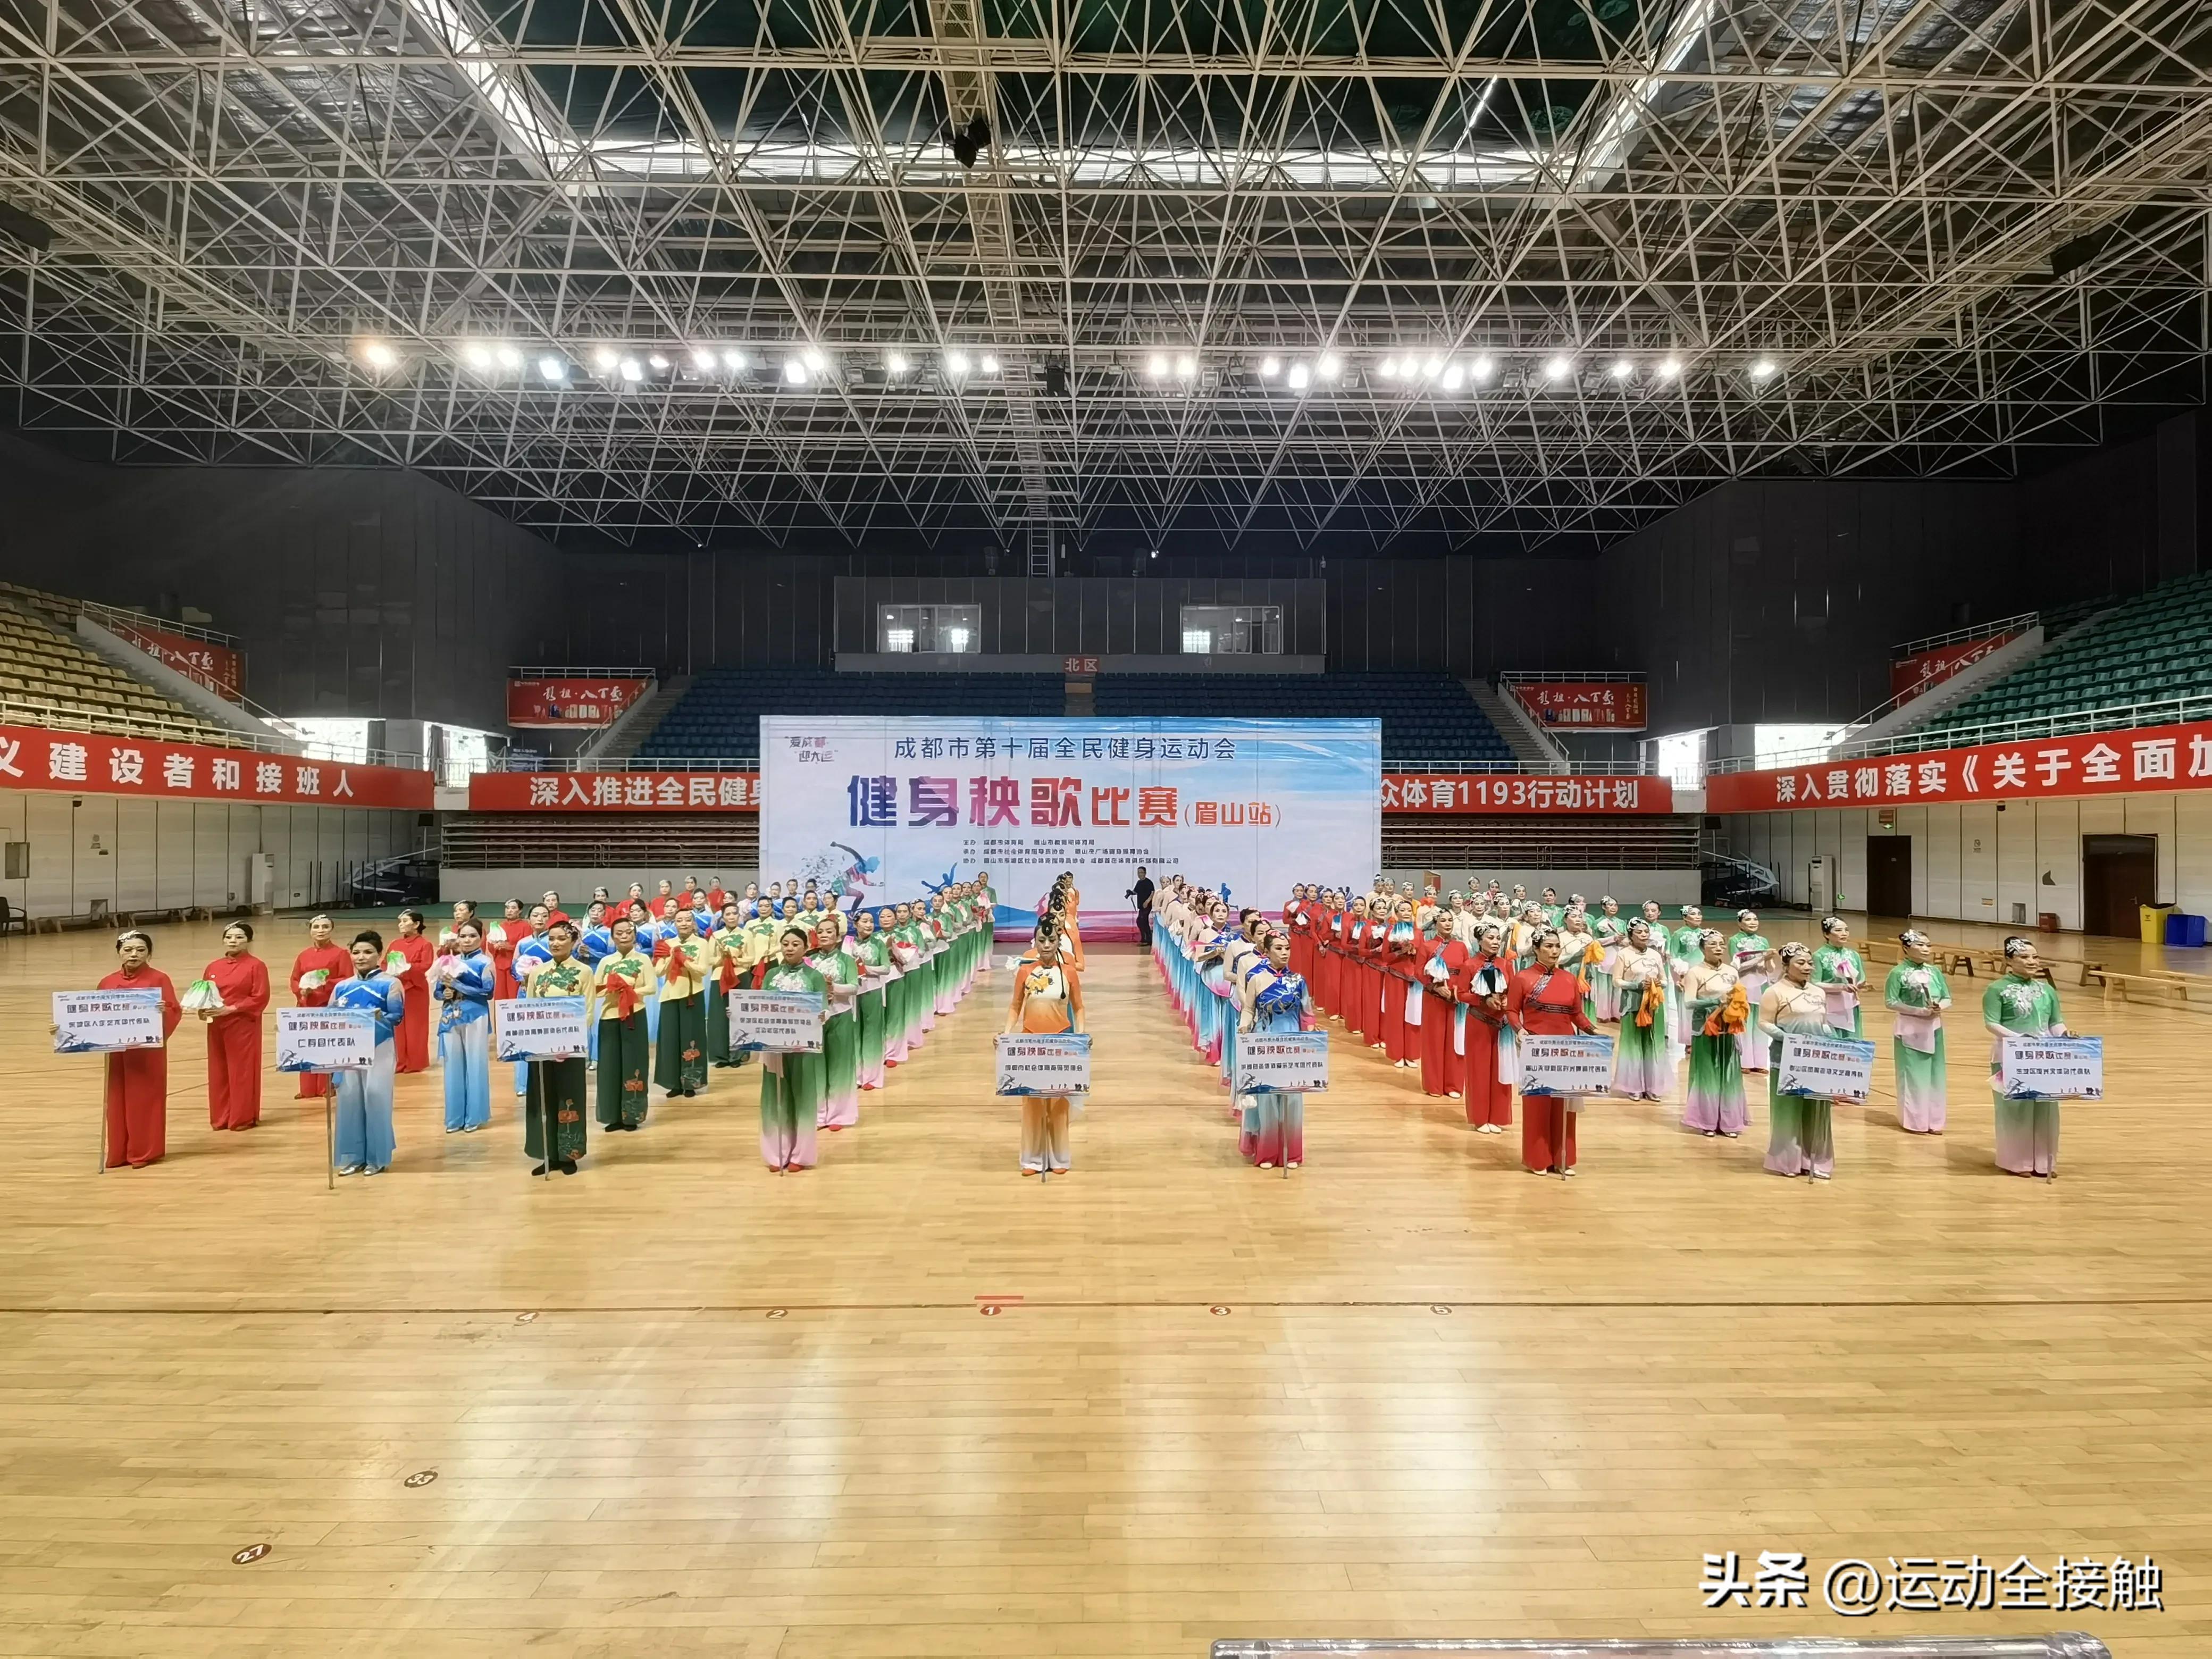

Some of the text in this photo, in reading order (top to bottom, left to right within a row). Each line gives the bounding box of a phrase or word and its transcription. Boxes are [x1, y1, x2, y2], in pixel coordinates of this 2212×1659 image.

[1065, 658, 1097, 672] 北区
[894, 736, 1235, 760] 成都市第十届全民健身运动会
[1381, 779, 1639, 808] 众体育1193行动计划
[519, 1312, 536, 1321] 4
[769, 1310, 785, 1318] 2
[1214, 1306, 1228, 1315] 3
[237, 1544, 264, 1563] 27
